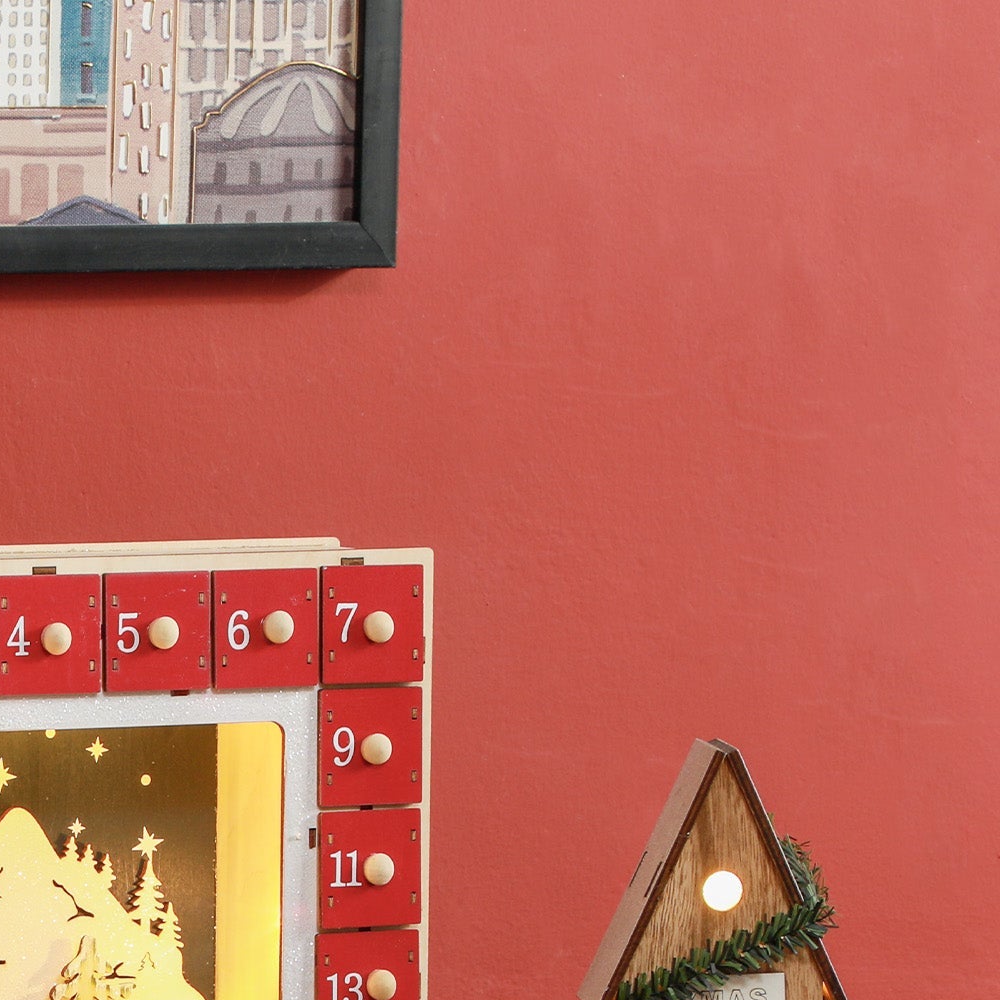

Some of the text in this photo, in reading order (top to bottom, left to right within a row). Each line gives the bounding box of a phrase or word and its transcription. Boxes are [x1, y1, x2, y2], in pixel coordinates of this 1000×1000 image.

[7, 616, 30, 656] 4
[117, 613, 139, 653] 5
[228, 610, 249, 650] 6
[336, 603, 358, 642] 7
[333, 727, 354, 766] 9
[330, 850, 362, 887] 11
